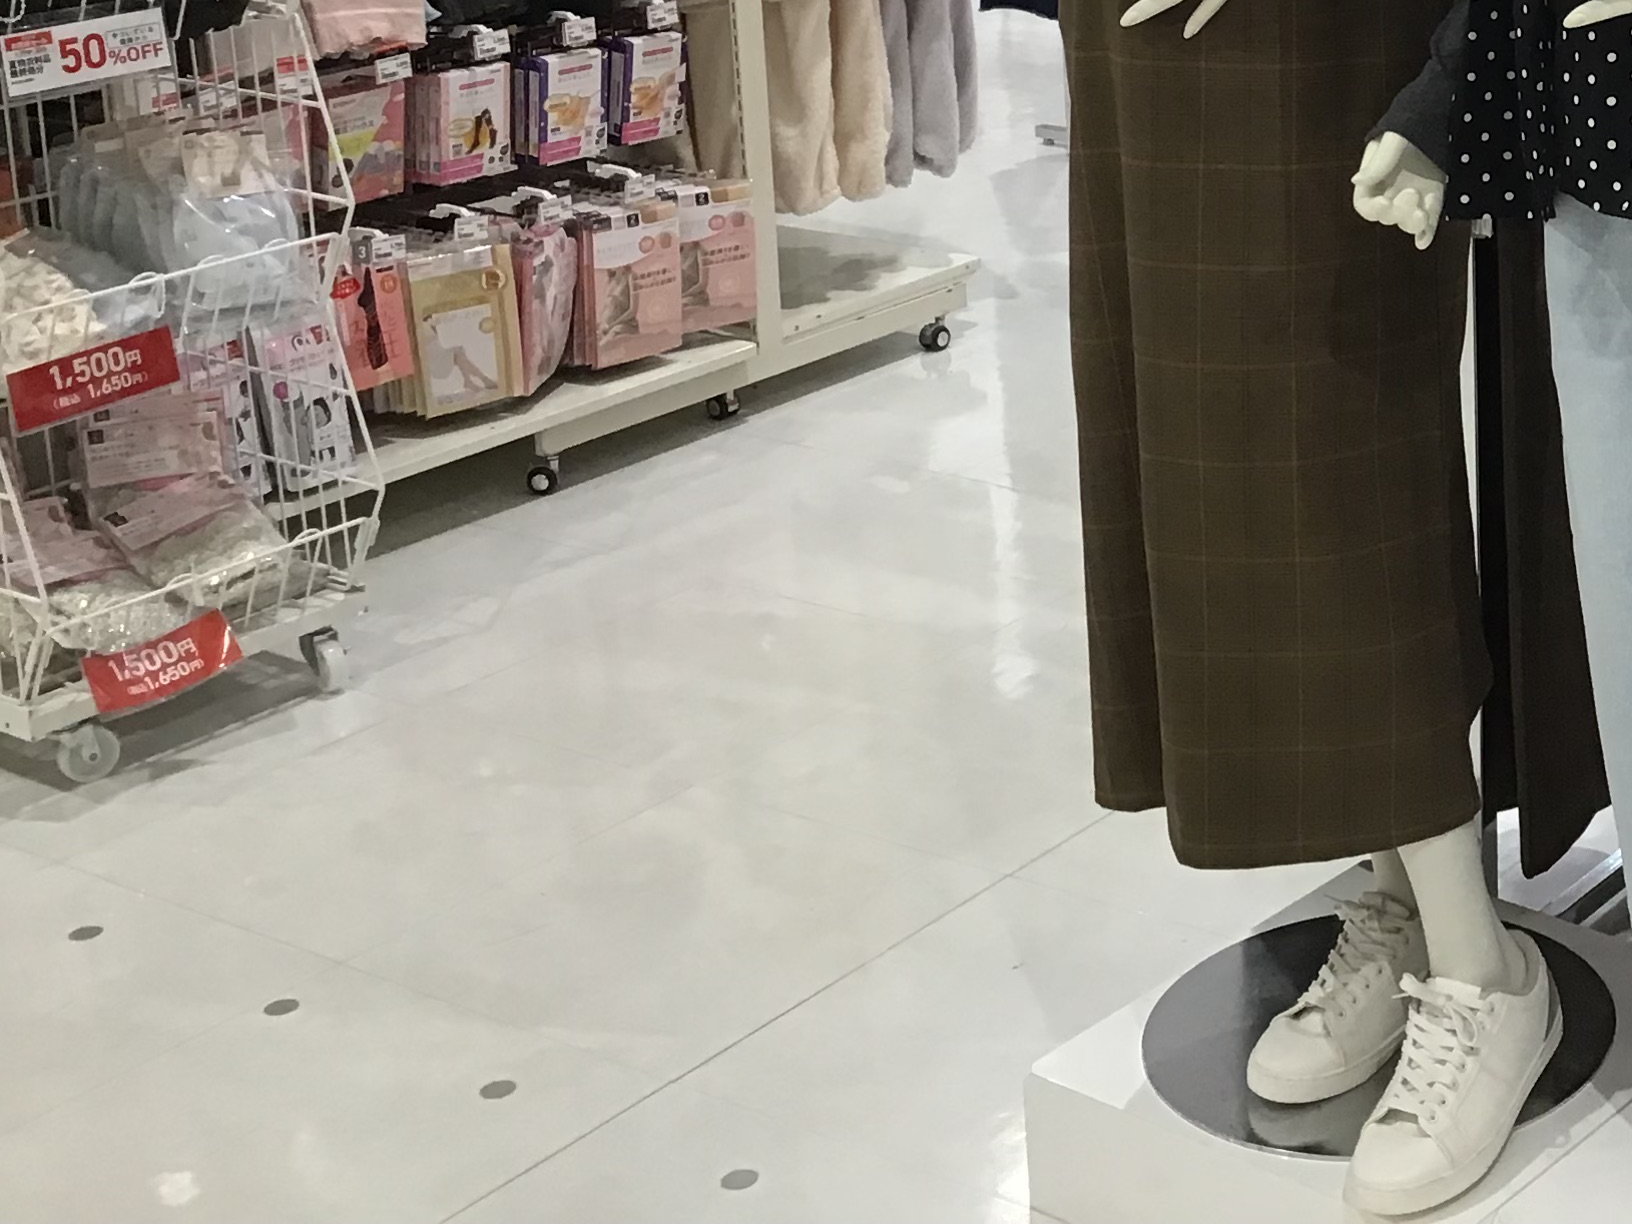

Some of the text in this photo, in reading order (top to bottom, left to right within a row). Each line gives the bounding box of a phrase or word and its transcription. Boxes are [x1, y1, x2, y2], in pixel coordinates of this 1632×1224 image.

[357, 245, 367, 259] 3
[49, 345, 143, 391] 1,500円
[107, 637, 200, 682] 1,500円
